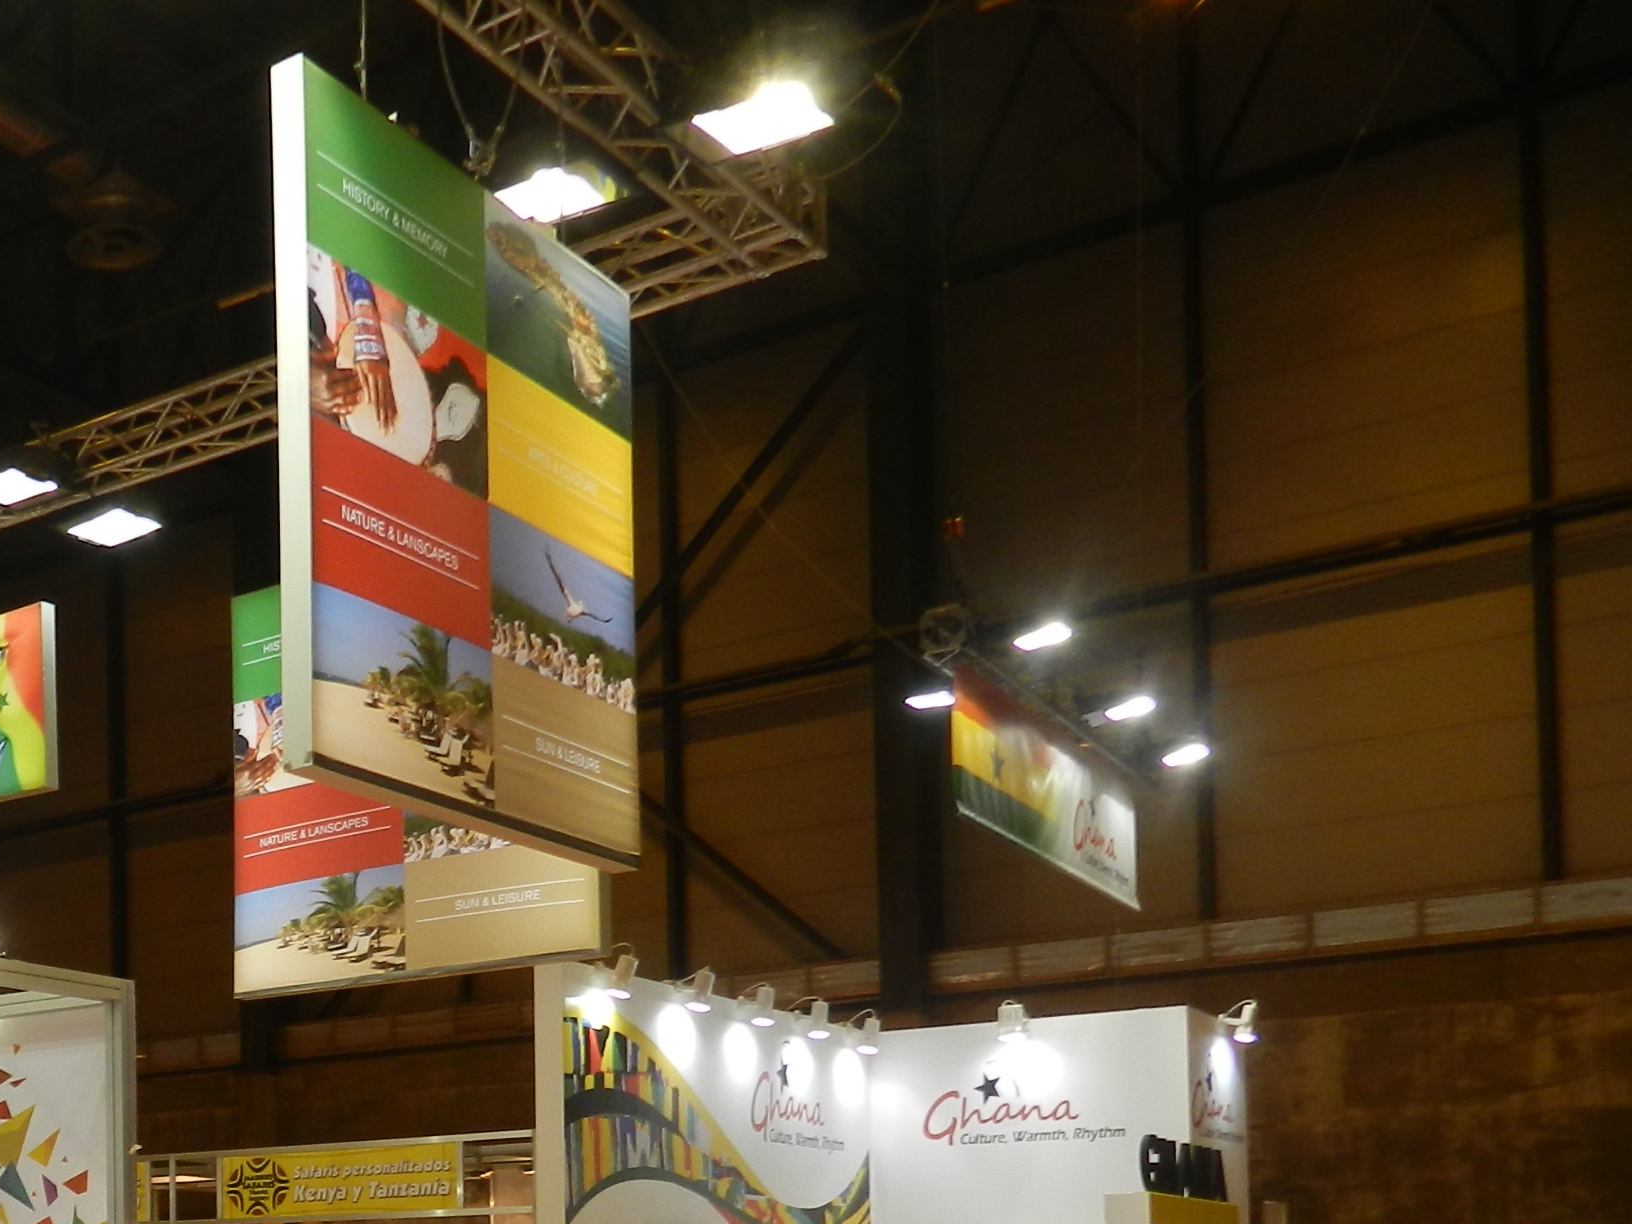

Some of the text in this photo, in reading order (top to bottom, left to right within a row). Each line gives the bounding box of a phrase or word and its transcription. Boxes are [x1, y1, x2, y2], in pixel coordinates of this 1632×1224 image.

[342, 178, 448, 258] HISTORY & MEMORY
[341, 504, 459, 571] NATURE & LANSCAPES
[259, 816, 369, 848] NATURE & LANSCAPES
[454, 889, 541, 911] SUN & LEISURE
[751, 1071, 825, 1142] Ghana
[922, 1089, 1080, 1146] Ghana
[960, 1126, 1126, 1146] Culture, Warmth, Rhythm
[293, 1158, 452, 1180] Safaris personalizados
[293, 1184, 347, 1205] Kenya
[353, 1186, 364, 1203] y
